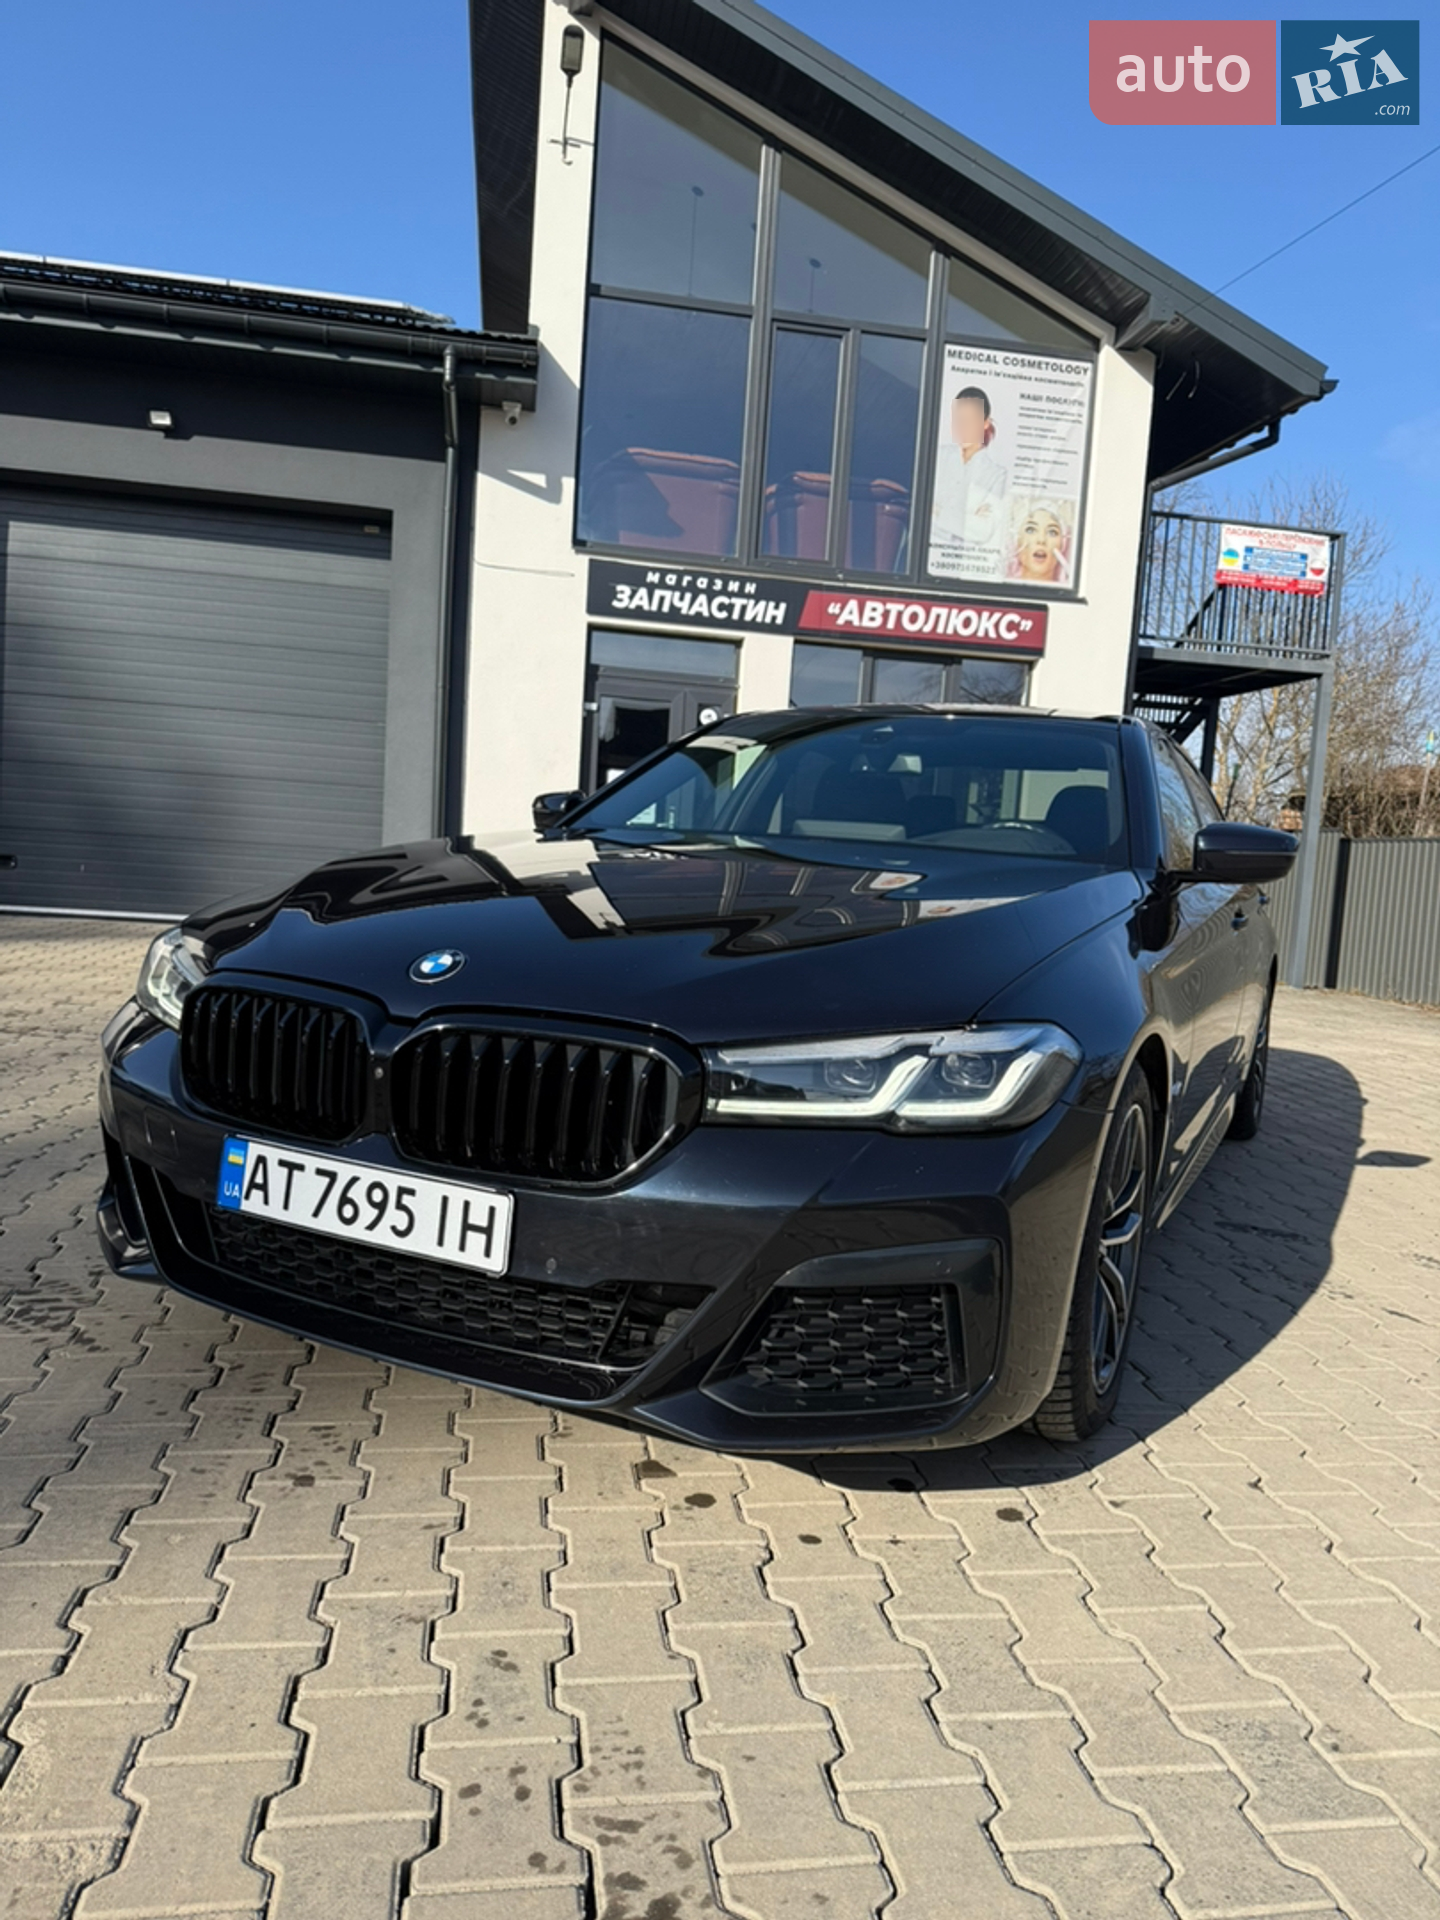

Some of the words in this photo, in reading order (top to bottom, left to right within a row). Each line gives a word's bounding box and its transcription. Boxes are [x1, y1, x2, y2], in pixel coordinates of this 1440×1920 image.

[947, 349, 999, 364] MEDICAL
[1002, 356, 1090, 376] COSMETOLOGY
[646, 571, 757, 594] магазин
[611, 584, 788, 625] ЗАПЧАСТИН
[223, 1182, 240, 1198] UA
